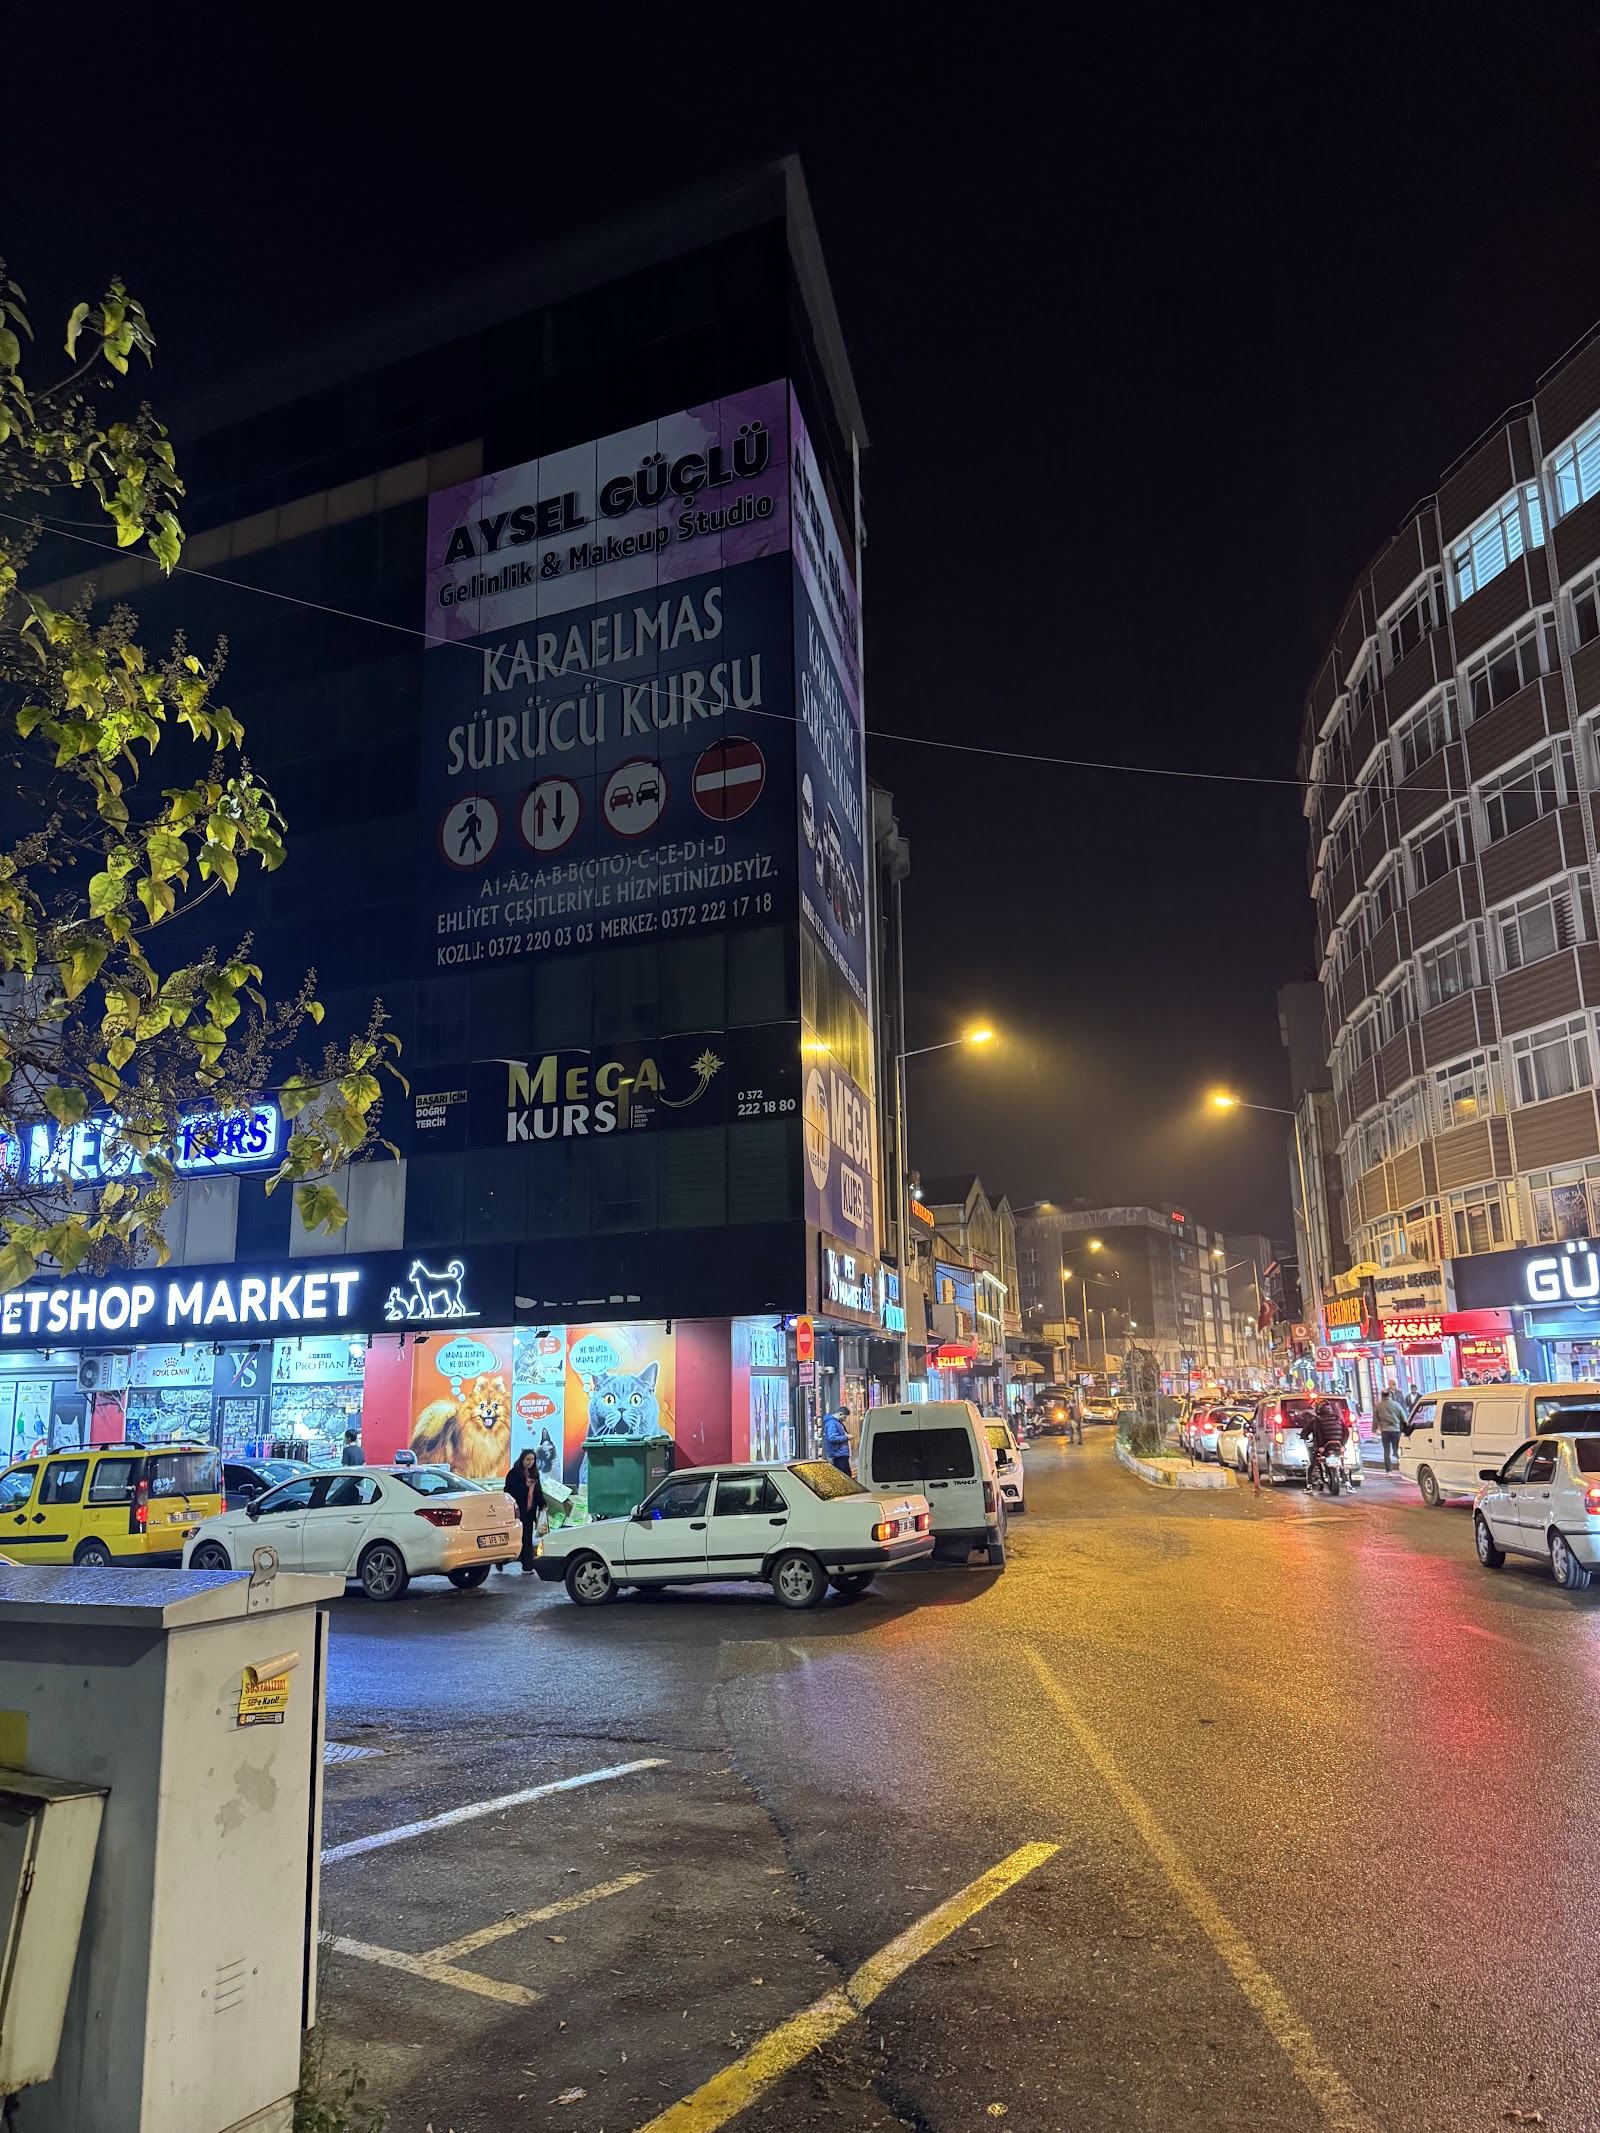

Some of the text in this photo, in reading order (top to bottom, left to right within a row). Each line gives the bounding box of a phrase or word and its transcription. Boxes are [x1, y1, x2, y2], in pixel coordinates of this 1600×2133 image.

[444, 420, 769, 566] AYSEL GÜÇLÜ
[439, 494, 773, 607] Gelinlik & Makeup Studio
[482, 586, 723, 697] KARAELMAS
[447, 680, 606, 776] SÜRÜCÜ
[621, 652, 763, 738] KURSU
[437, 852, 779, 935] EHLİYET ÇEŞİTLERİYLE HİZMETİNİZDEYİZ.
[437, 892, 772, 966] KOZLU: 0372 220 03 03 MERKEZ: 0372 222 17 18
[508, 1056, 665, 1108] MEGA
[738, 1090, 763, 1101] 0 372
[416, 1106, 446, 1117] DOĞRU
[417, 1095, 448, 1106] BAŞARI
[738, 1098, 796, 1116] 222 18 80
[416, 1116, 446, 1129] TERCİH
[507, 1100, 617, 1142] KURS
[831, 1069, 872, 1176] MEGA
[842, 1172, 863, 1221] KURS
[844, 1254, 856, 1280] PET
[0, 1271, 359, 1335] ETSHOP MARKET
[839, 1280, 862, 1310] MARKET
[1386, 1322, 1440, 1338] KASAP
[295, 1362, 317, 1371] PRO
[589, 1345, 608, 1353] DEMEK
[152, 1368, 190, 1377] ROYAL CANIN
